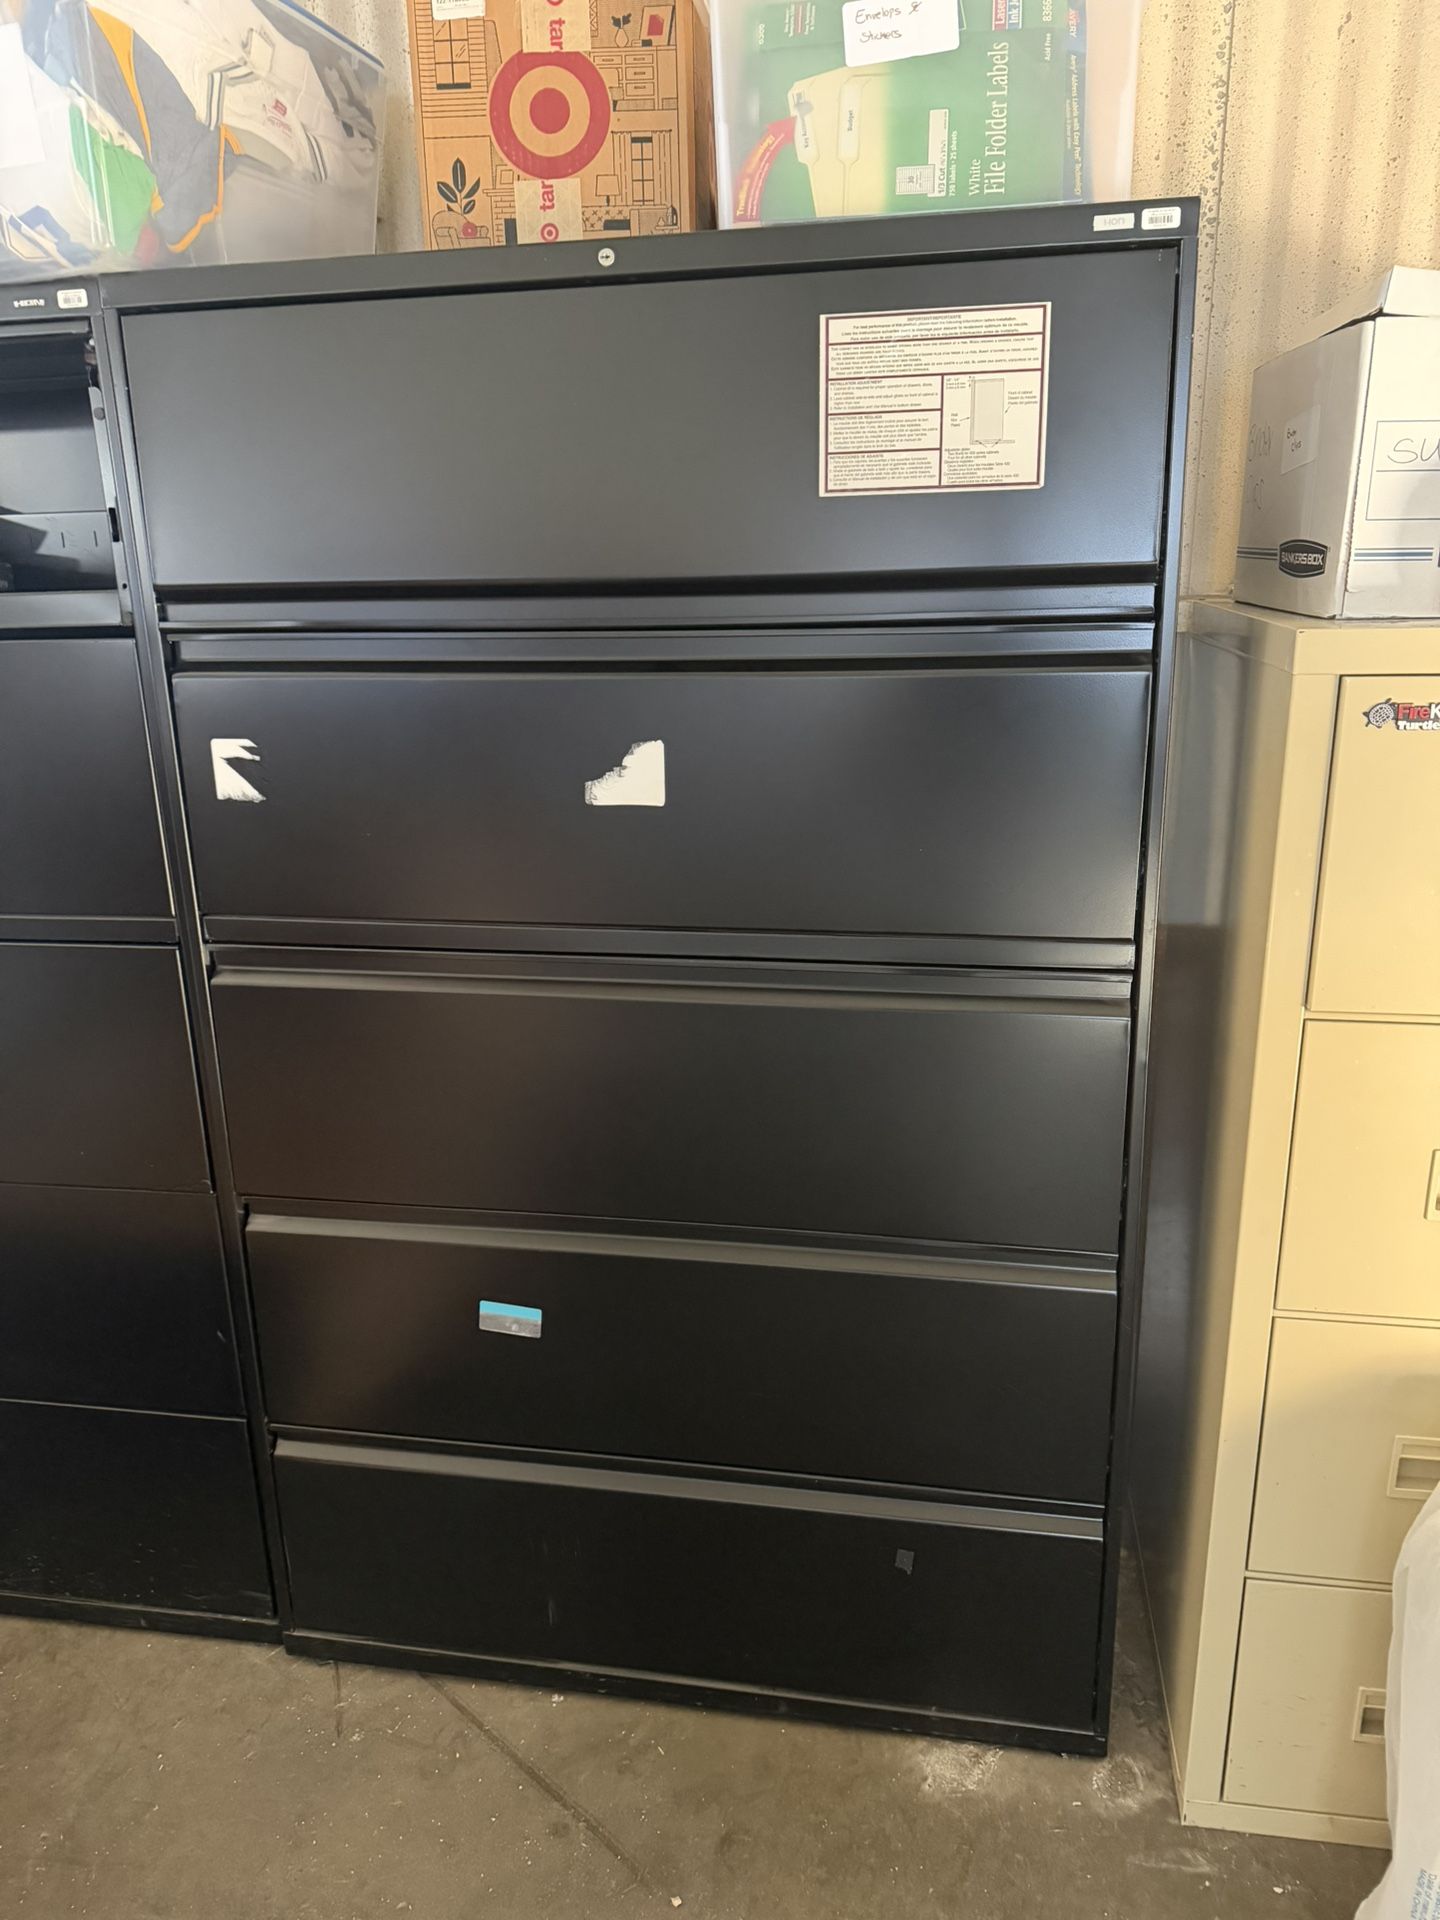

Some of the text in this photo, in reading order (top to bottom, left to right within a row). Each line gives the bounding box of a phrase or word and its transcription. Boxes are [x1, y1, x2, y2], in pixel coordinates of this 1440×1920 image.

[983, 41, 1010, 196] File Folder Labels
[968, 158, 981, 197] White
[1307, 552, 1324, 566] BOX
